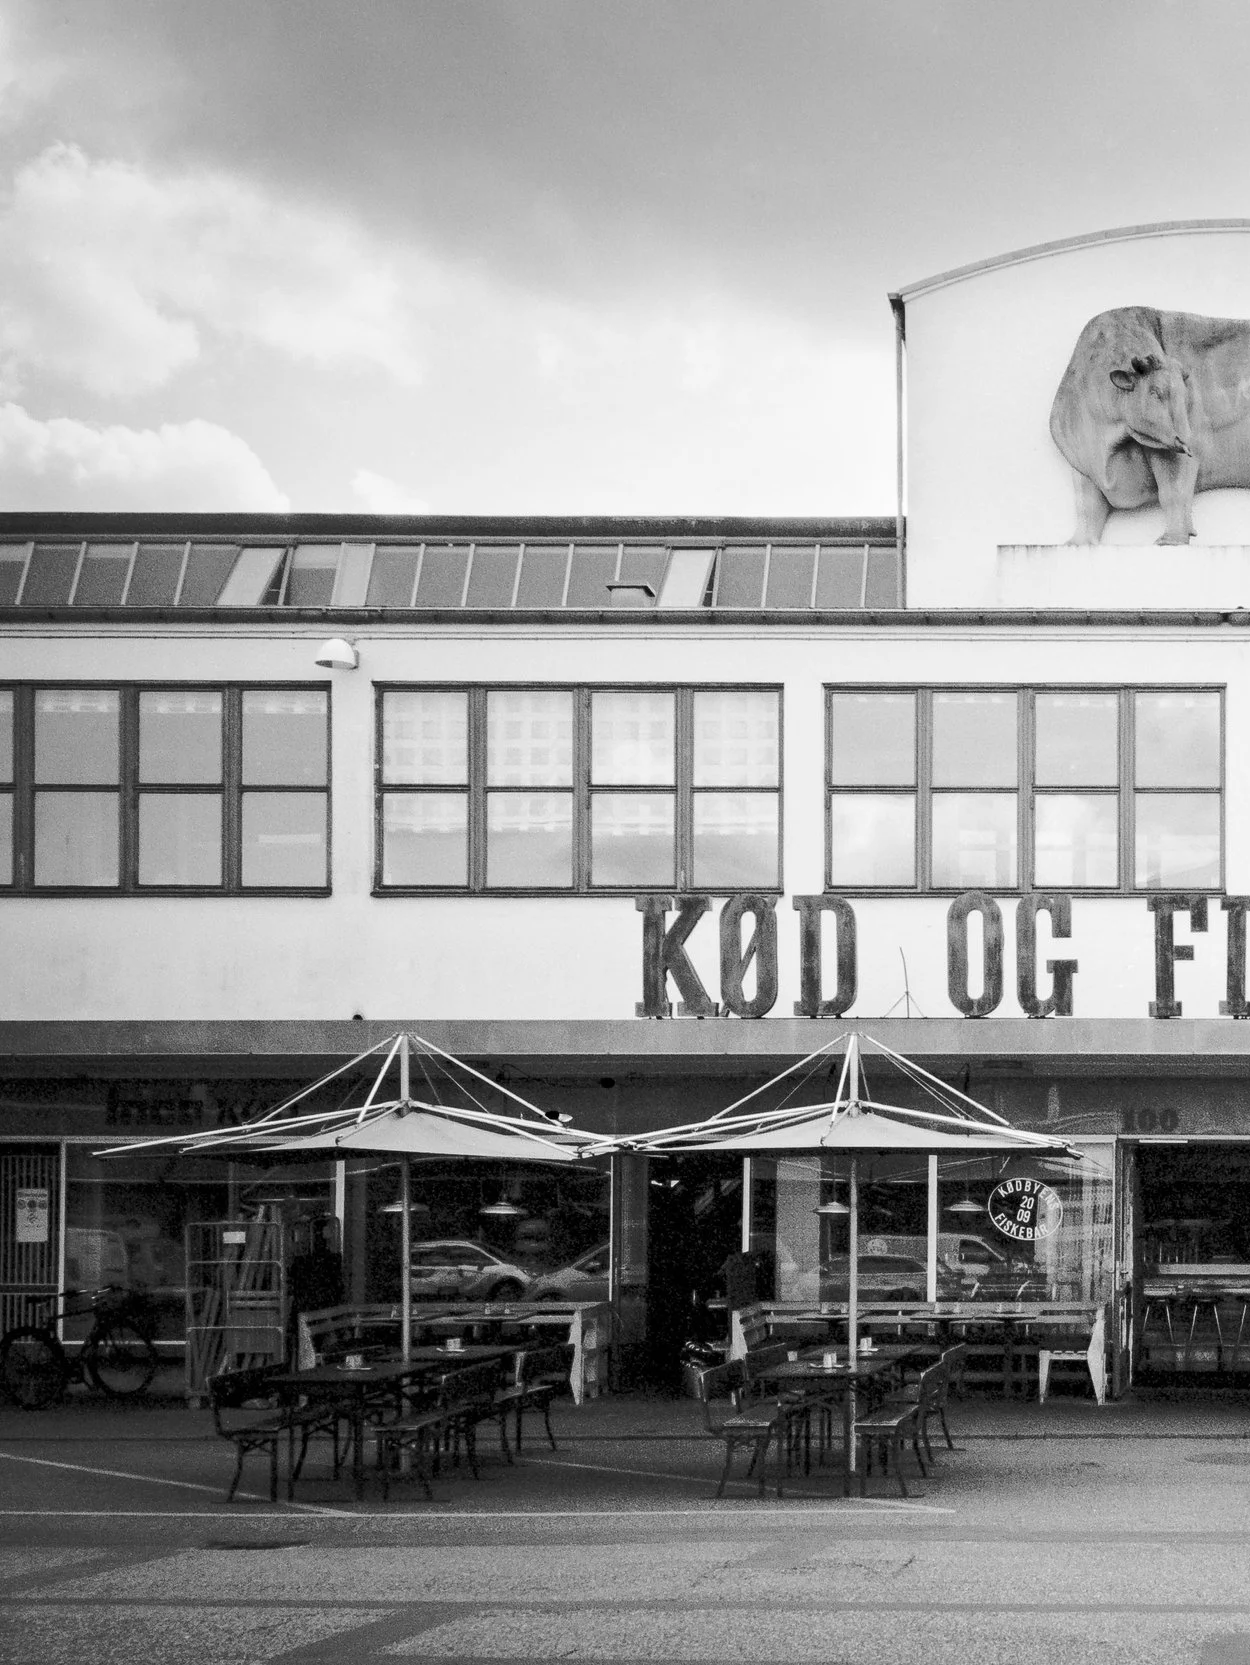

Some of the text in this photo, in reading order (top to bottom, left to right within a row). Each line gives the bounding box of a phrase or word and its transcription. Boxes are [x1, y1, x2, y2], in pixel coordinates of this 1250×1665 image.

[635, 892, 858, 1018] KØD
[946, 891, 1079, 1018] OG
[997, 1180, 1059, 1210] KØDBYENS
[1020, 1195, 1034, 1209] 20
[995, 1213, 1049, 1239] FISKEBAR
[1016, 1209, 1031, 1223] 09
